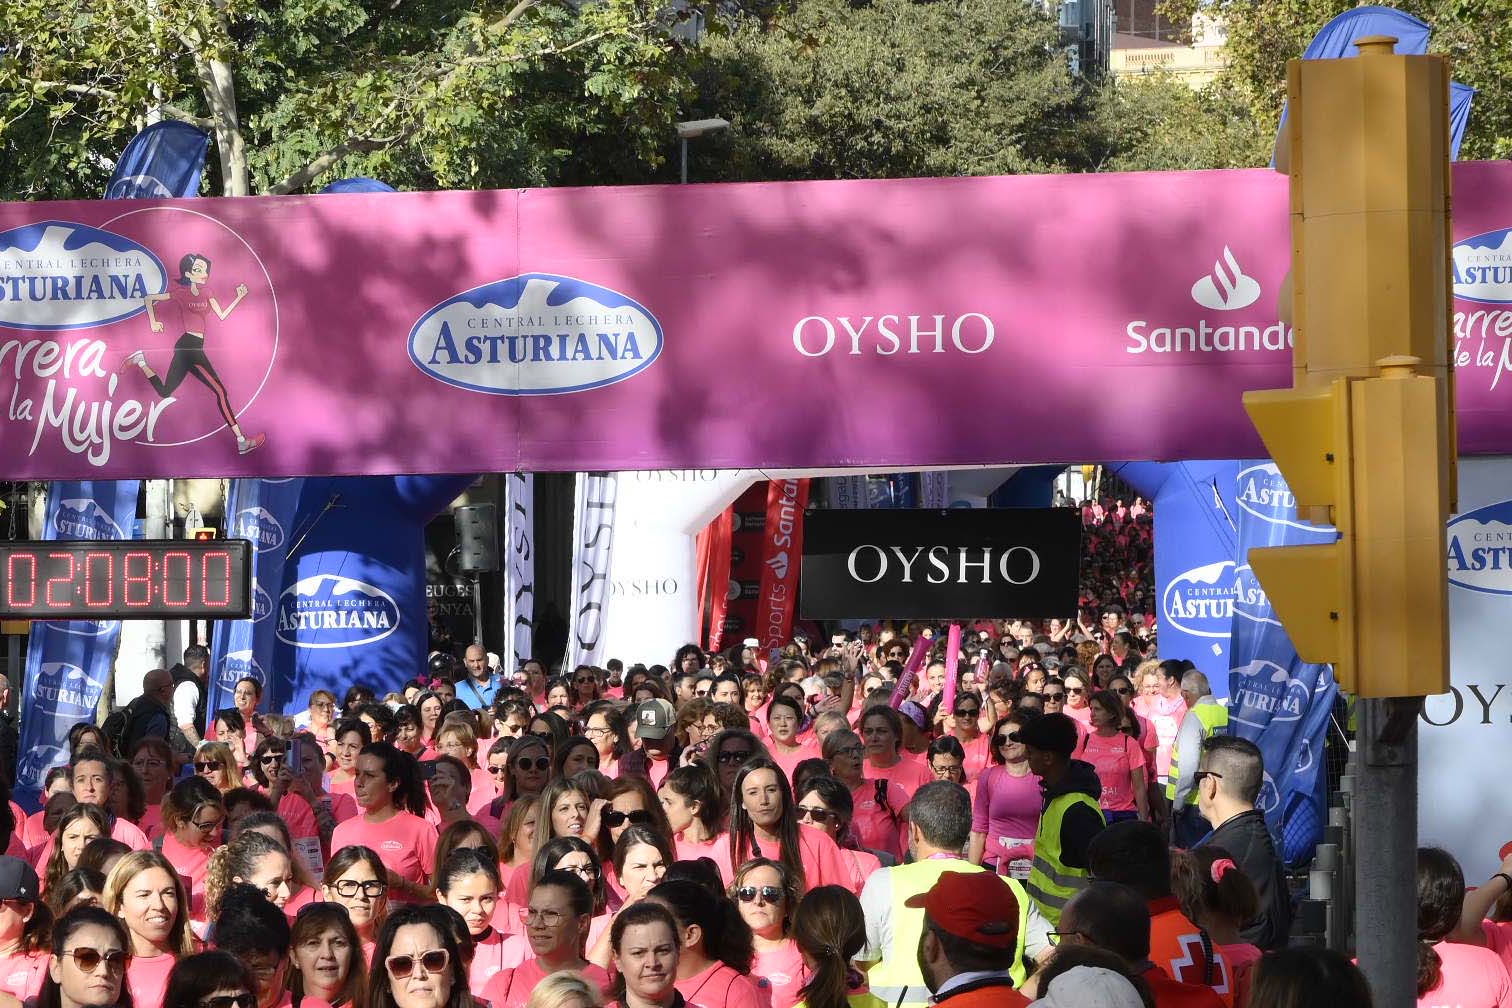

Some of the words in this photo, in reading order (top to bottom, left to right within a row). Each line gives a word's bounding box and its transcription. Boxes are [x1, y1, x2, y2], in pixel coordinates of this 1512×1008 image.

[70, 256, 143, 269] LECHERA
[467, 316, 546, 329] CENTRAL
[553, 314, 635, 327] LECHERA
[792, 312, 996, 357] OYSHO
[1126, 320, 1293, 354] Santand
[427, 321, 643, 366] ASTURIANA
[9, 384, 33, 421] la
[29, 373, 178, 467] Mujer
[8, 552, 230, 607] 02:08:00
[847, 544, 1040, 584] OYSHO
[278, 605, 391, 632] ASTURIANA
